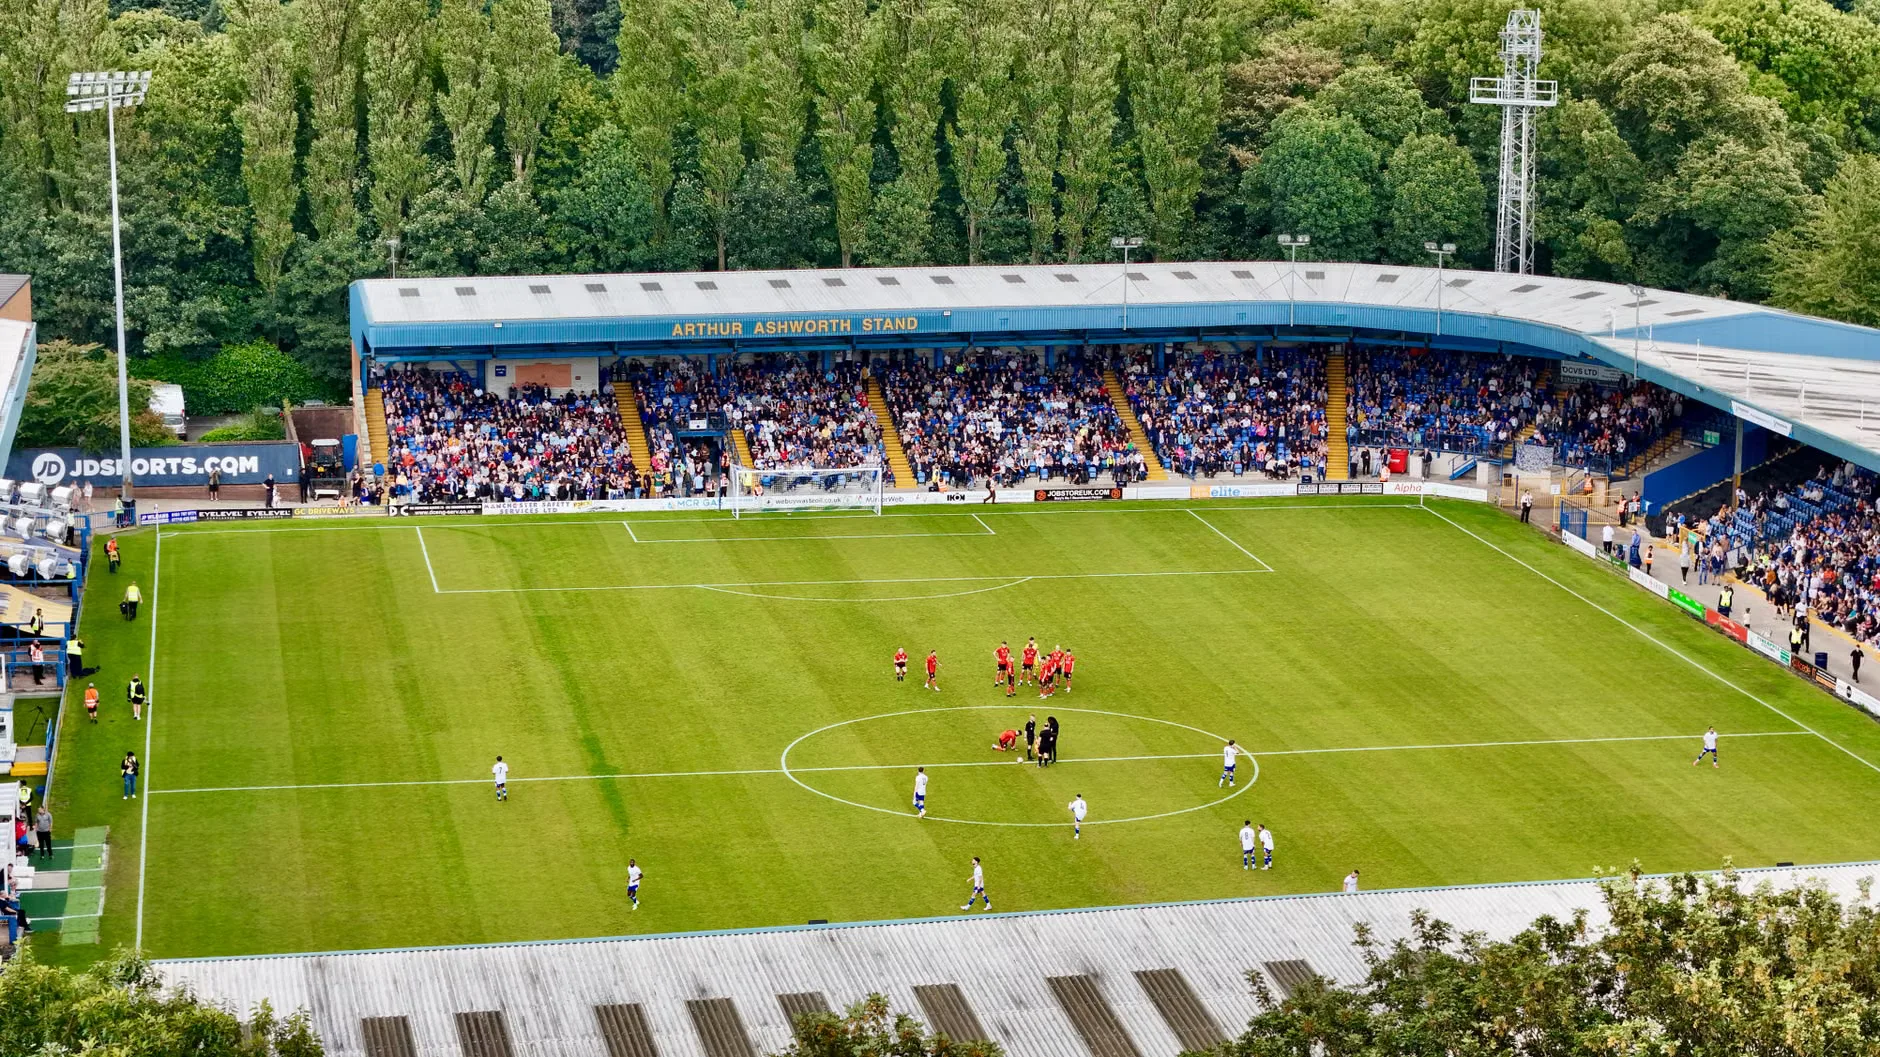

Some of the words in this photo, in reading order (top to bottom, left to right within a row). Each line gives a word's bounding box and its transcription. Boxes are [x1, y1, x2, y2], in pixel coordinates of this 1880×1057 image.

[672, 322, 743, 337] ARTHUR
[754, 319, 852, 335] ASHWORTH
[862, 316, 919, 332] STAND
[1584, 368, 1598, 377] LTD
[37, 460, 62, 477] JD
[1211, 486, 1241, 496] elite
[1394, 483, 1422, 493] Alpha
[1047, 489, 1110, 497] JOBSTOREUK.COM
[677, 499, 699, 507] MCR
[308, 507, 355, 515] DRIVEWAYS
